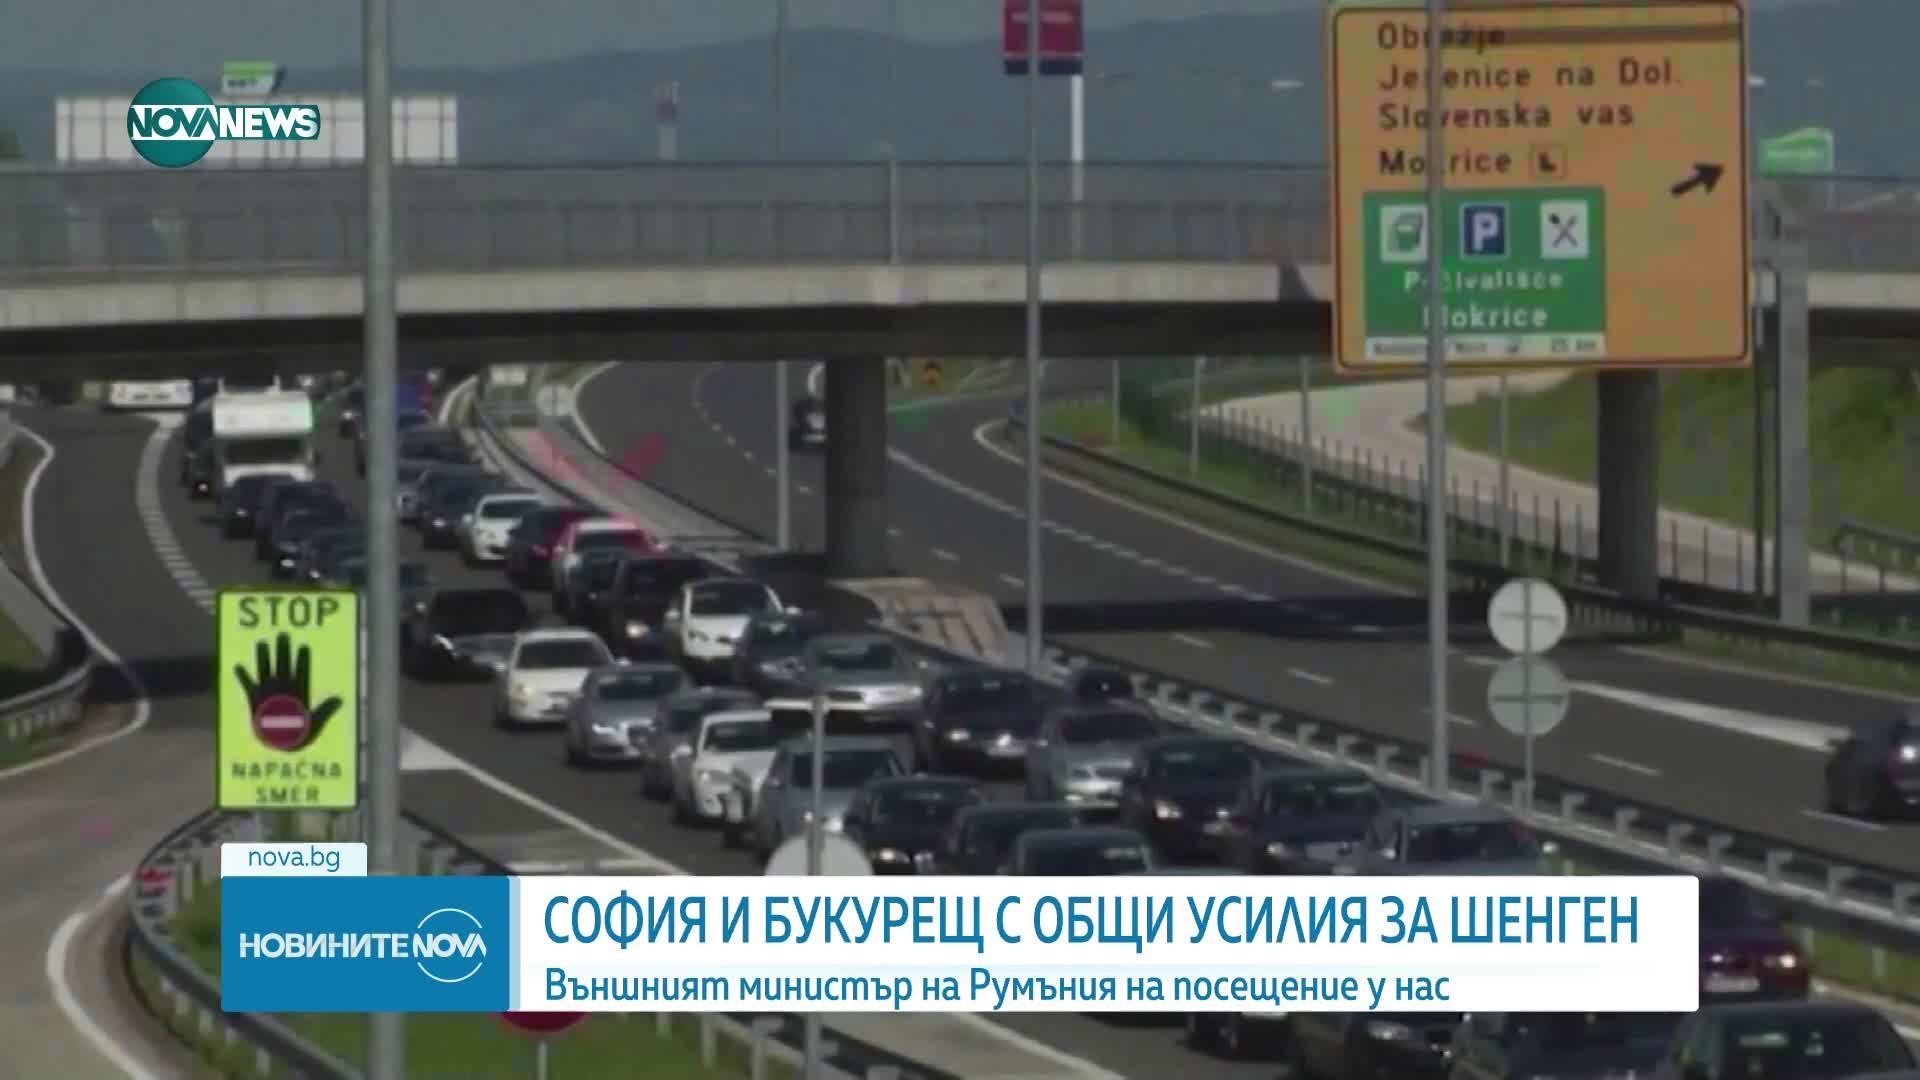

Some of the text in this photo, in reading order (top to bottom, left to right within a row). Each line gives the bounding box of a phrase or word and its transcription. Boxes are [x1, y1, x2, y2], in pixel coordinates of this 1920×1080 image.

[1380, 63, 1531, 91] Jeenice
[1556, 66, 1595, 87] na
[1577, 104, 1634, 126] vas
[1379, 148, 1512, 174] Morice
[238, 596, 340, 628] STOP
